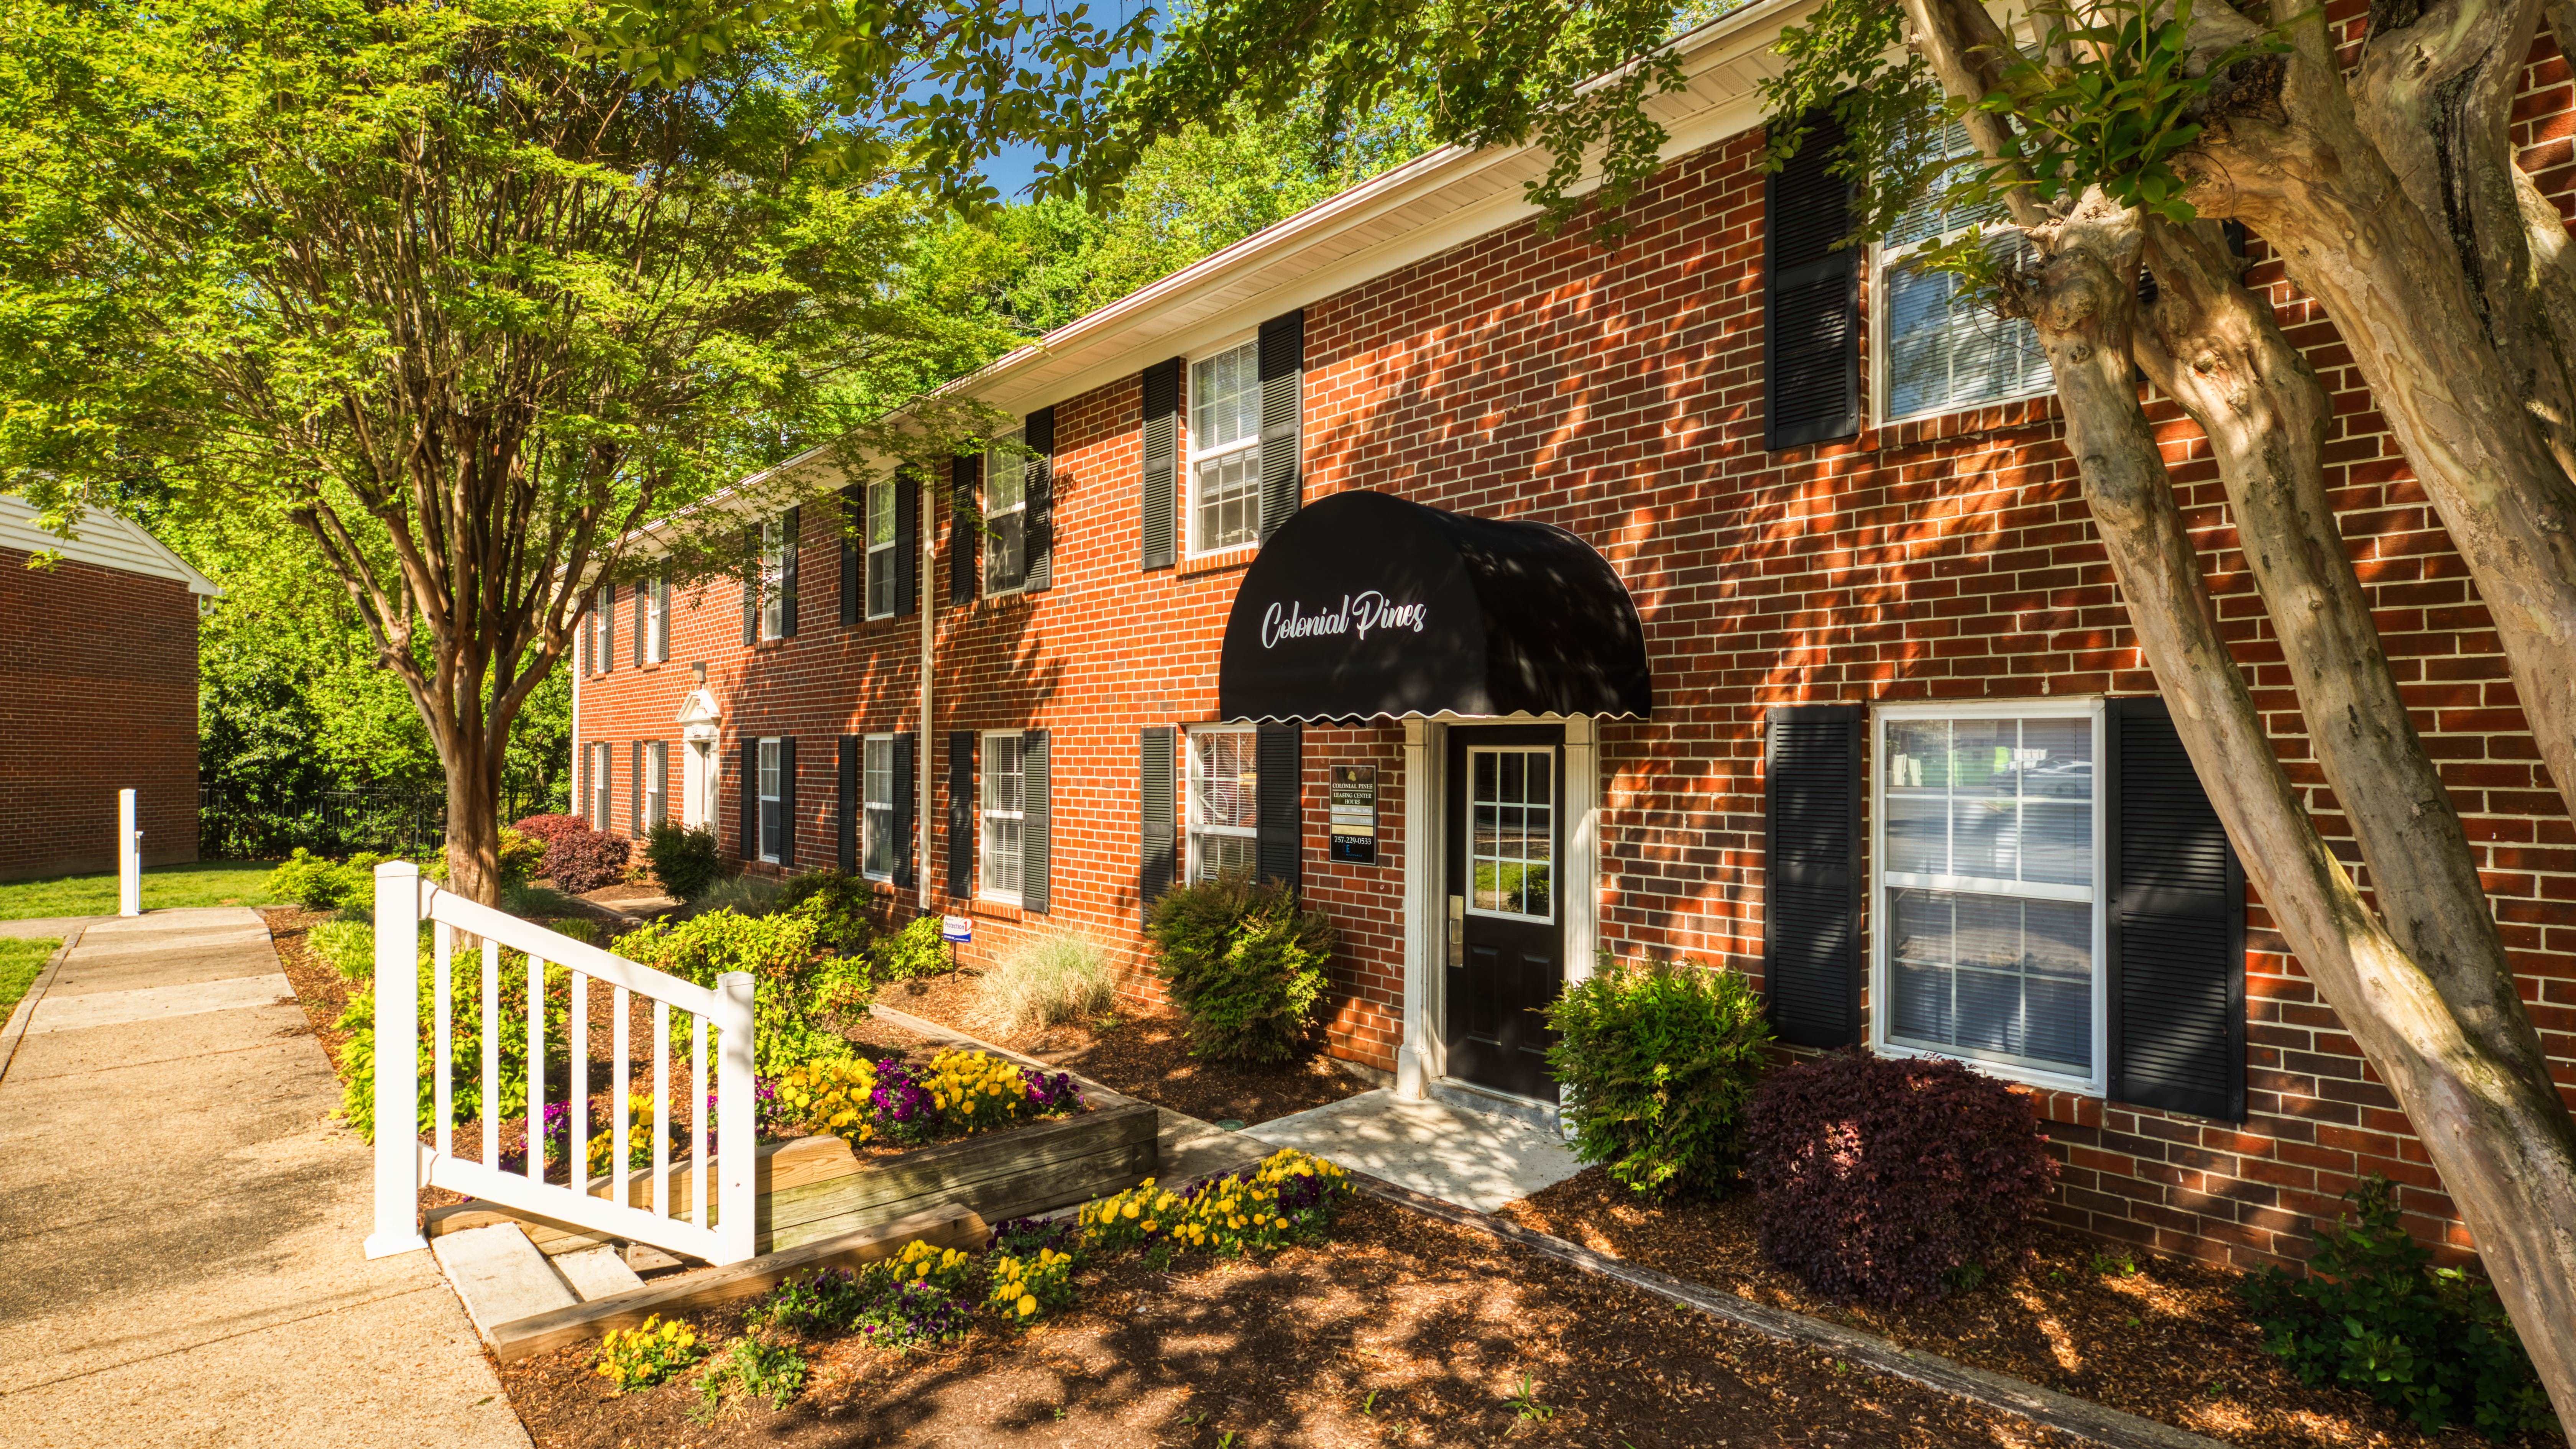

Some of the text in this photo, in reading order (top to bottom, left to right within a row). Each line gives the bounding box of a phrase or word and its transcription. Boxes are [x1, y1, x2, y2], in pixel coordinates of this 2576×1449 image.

[1262, 590, 1426, 648] Colonial Pines
[1334, 836, 1371, 845] 757-229-0533
[945, 922, 964, 930] Protection
